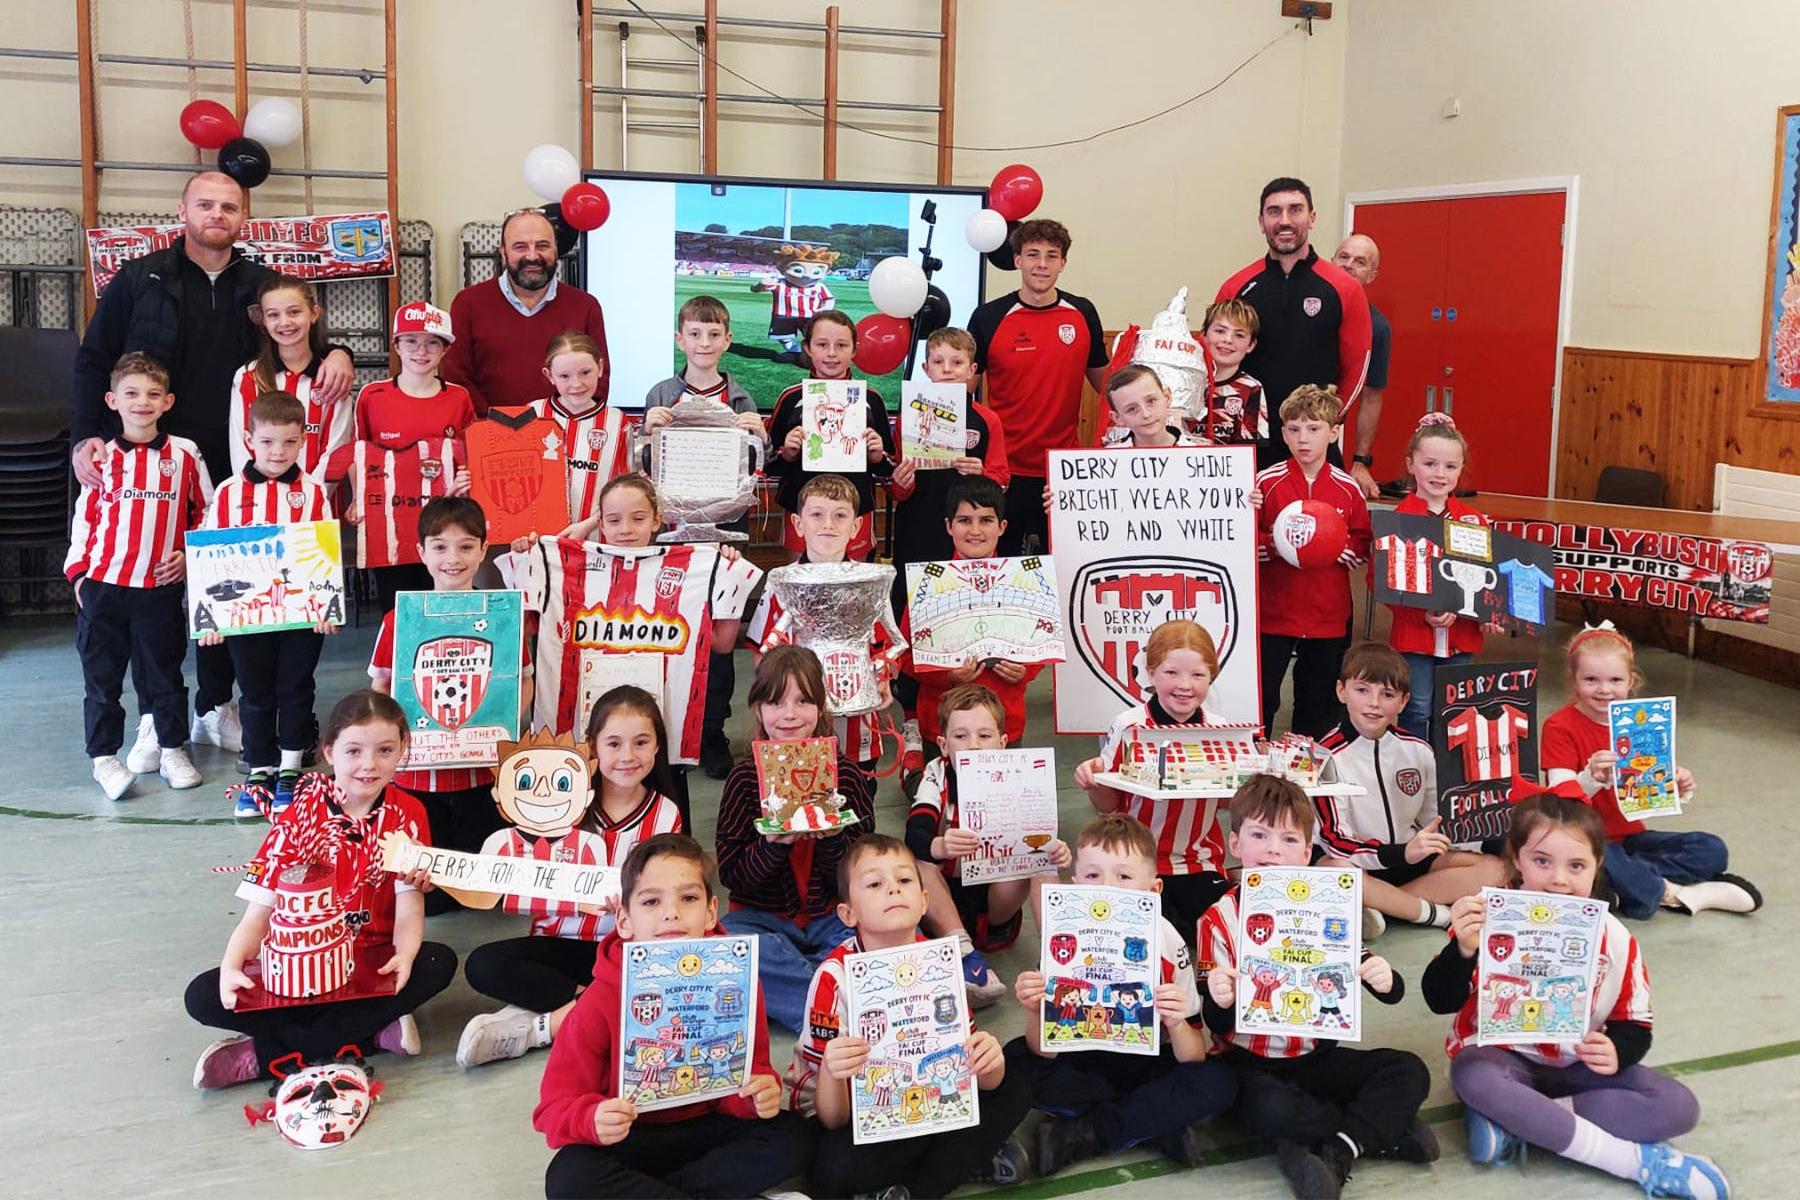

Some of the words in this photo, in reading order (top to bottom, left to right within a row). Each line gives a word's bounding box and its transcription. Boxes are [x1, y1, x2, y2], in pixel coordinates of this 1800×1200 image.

[272, 254, 322, 264] FROM
[568, 459, 598, 471] MOND
[1062, 457, 1118, 480] DERRY
[1131, 456, 1169, 479] CITY
[1186, 455, 1233, 479] SHINE
[123, 488, 177, 500] Diamond
[1129, 488, 1192, 510] WEAR
[1199, 487, 1247, 510] YOUR
[1078, 521, 1109, 542] RED
[1127, 520, 1162, 541] AND
[1177, 518, 1235, 541] WHITE
[1554, 568, 1645, 602] RRY
[1647, 581, 1714, 616] CITY
[1104, 610, 1151, 625] DERRY
[575, 620, 679, 641] DIAMOND
[1106, 625, 1154, 634] FOOTBAL
[421, 658, 457, 669] DERRY
[459, 656, 486, 667] CITY
[1446, 673, 1496, 704] DERRY
[1498, 668, 1538, 692] CITY
[417, 852, 479, 879] DERRY
[489, 862, 518, 885] FOR
[534, 866, 561, 890] THE
[574, 871, 605, 895] CUP
[1298, 909, 1313, 917] CITY
[271, 919, 345, 948] AMPIONS
[1278, 929, 1319, 937] WATERFORD
[1283, 955, 1312, 963] FINAL
[1085, 972, 1113, 981] FINAL
[689, 985, 704, 993] CITY
[892, 1016, 930, 1027] WATERFORD
[672, 1032, 701, 1040] FINAL
[899, 1047, 926, 1057] FINAL
